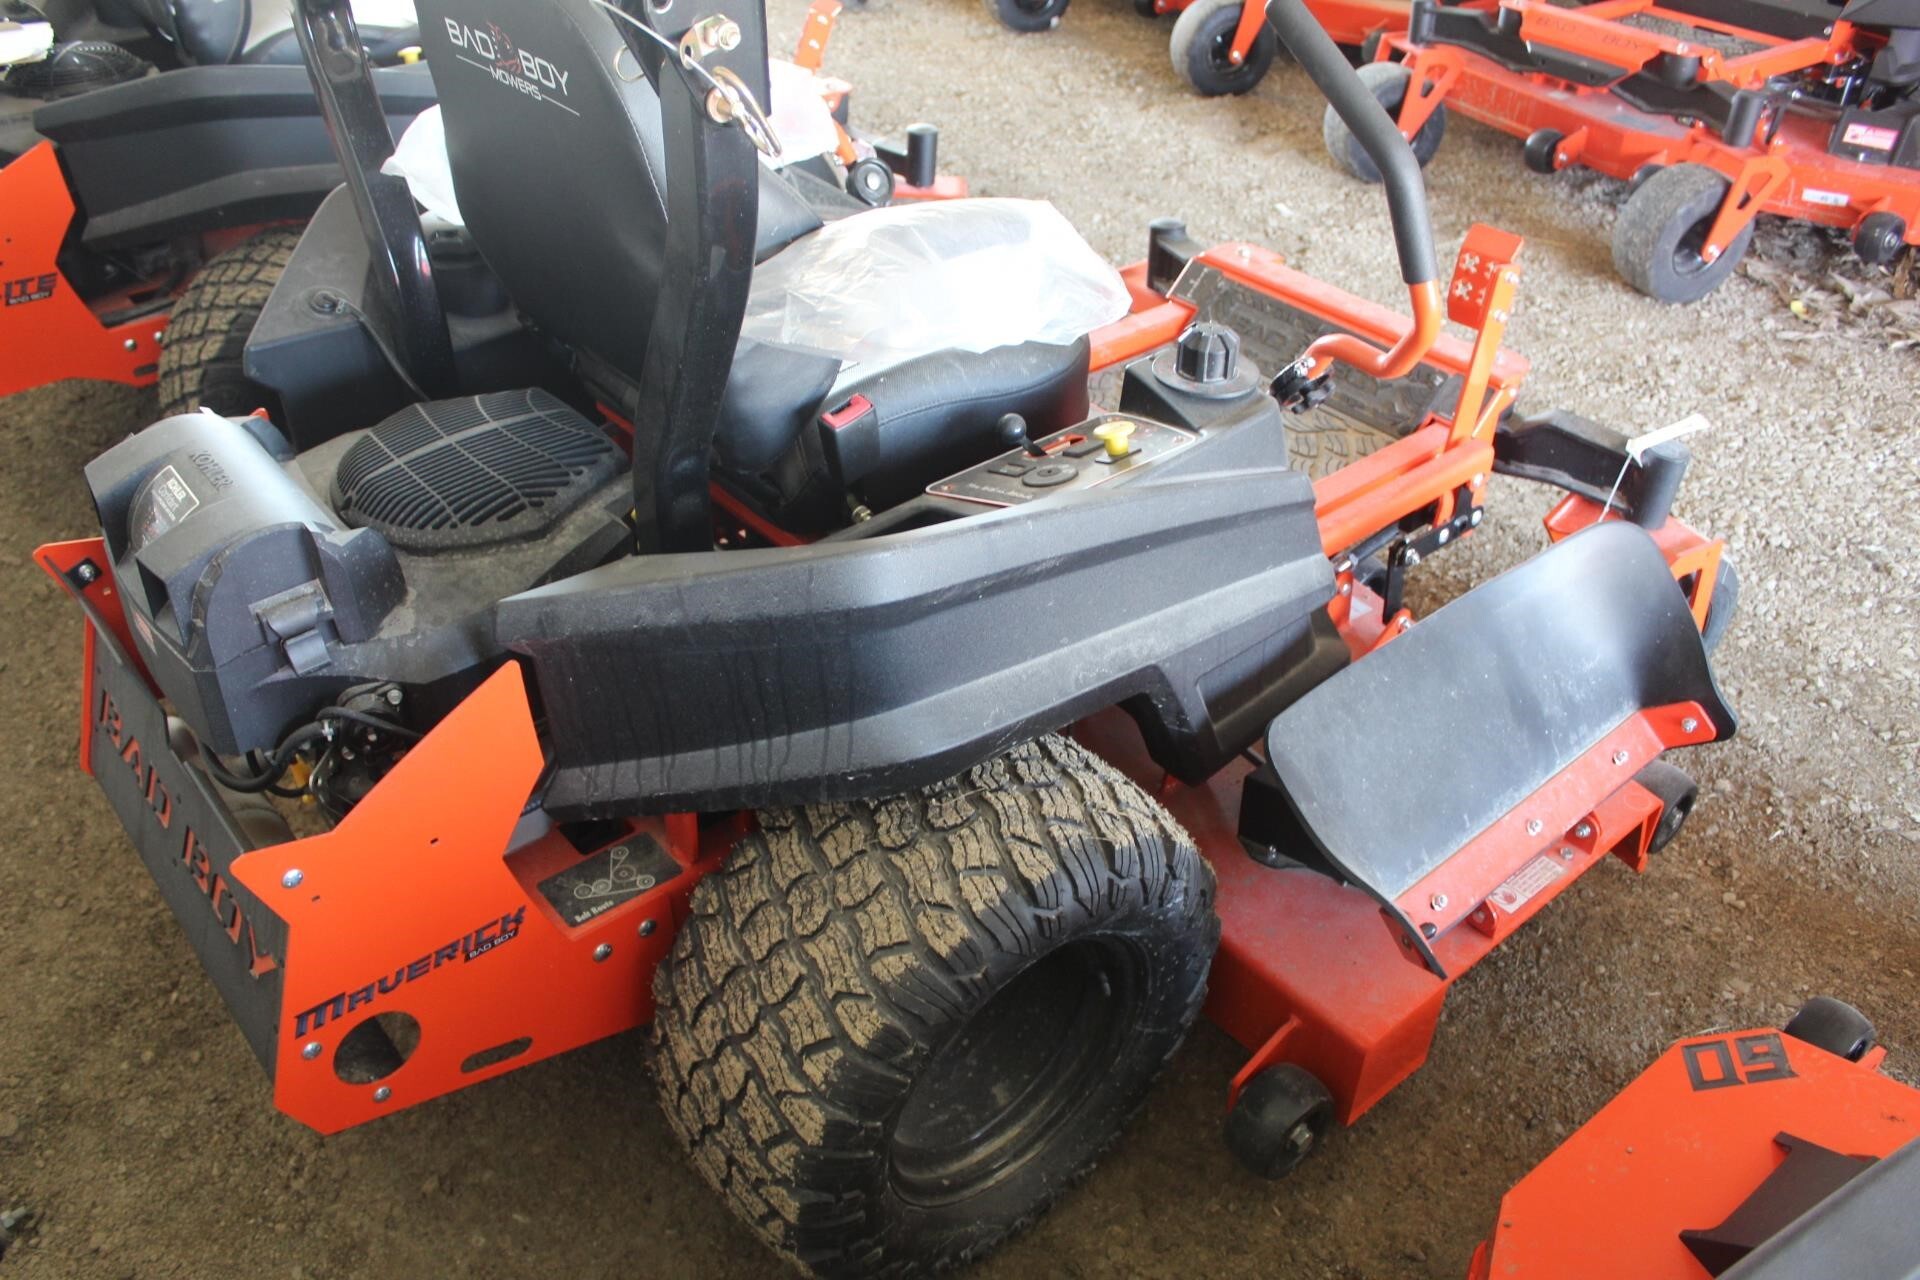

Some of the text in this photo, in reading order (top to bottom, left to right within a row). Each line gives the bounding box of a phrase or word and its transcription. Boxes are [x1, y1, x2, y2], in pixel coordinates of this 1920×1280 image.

[444, 16, 569, 97] BAD BOY
[489, 63, 542, 101] MOWERS
[0, 272, 58, 302] ITE
[99, 688, 279, 980] BAD BOY
[468, 928, 517, 960] BAD BOY
